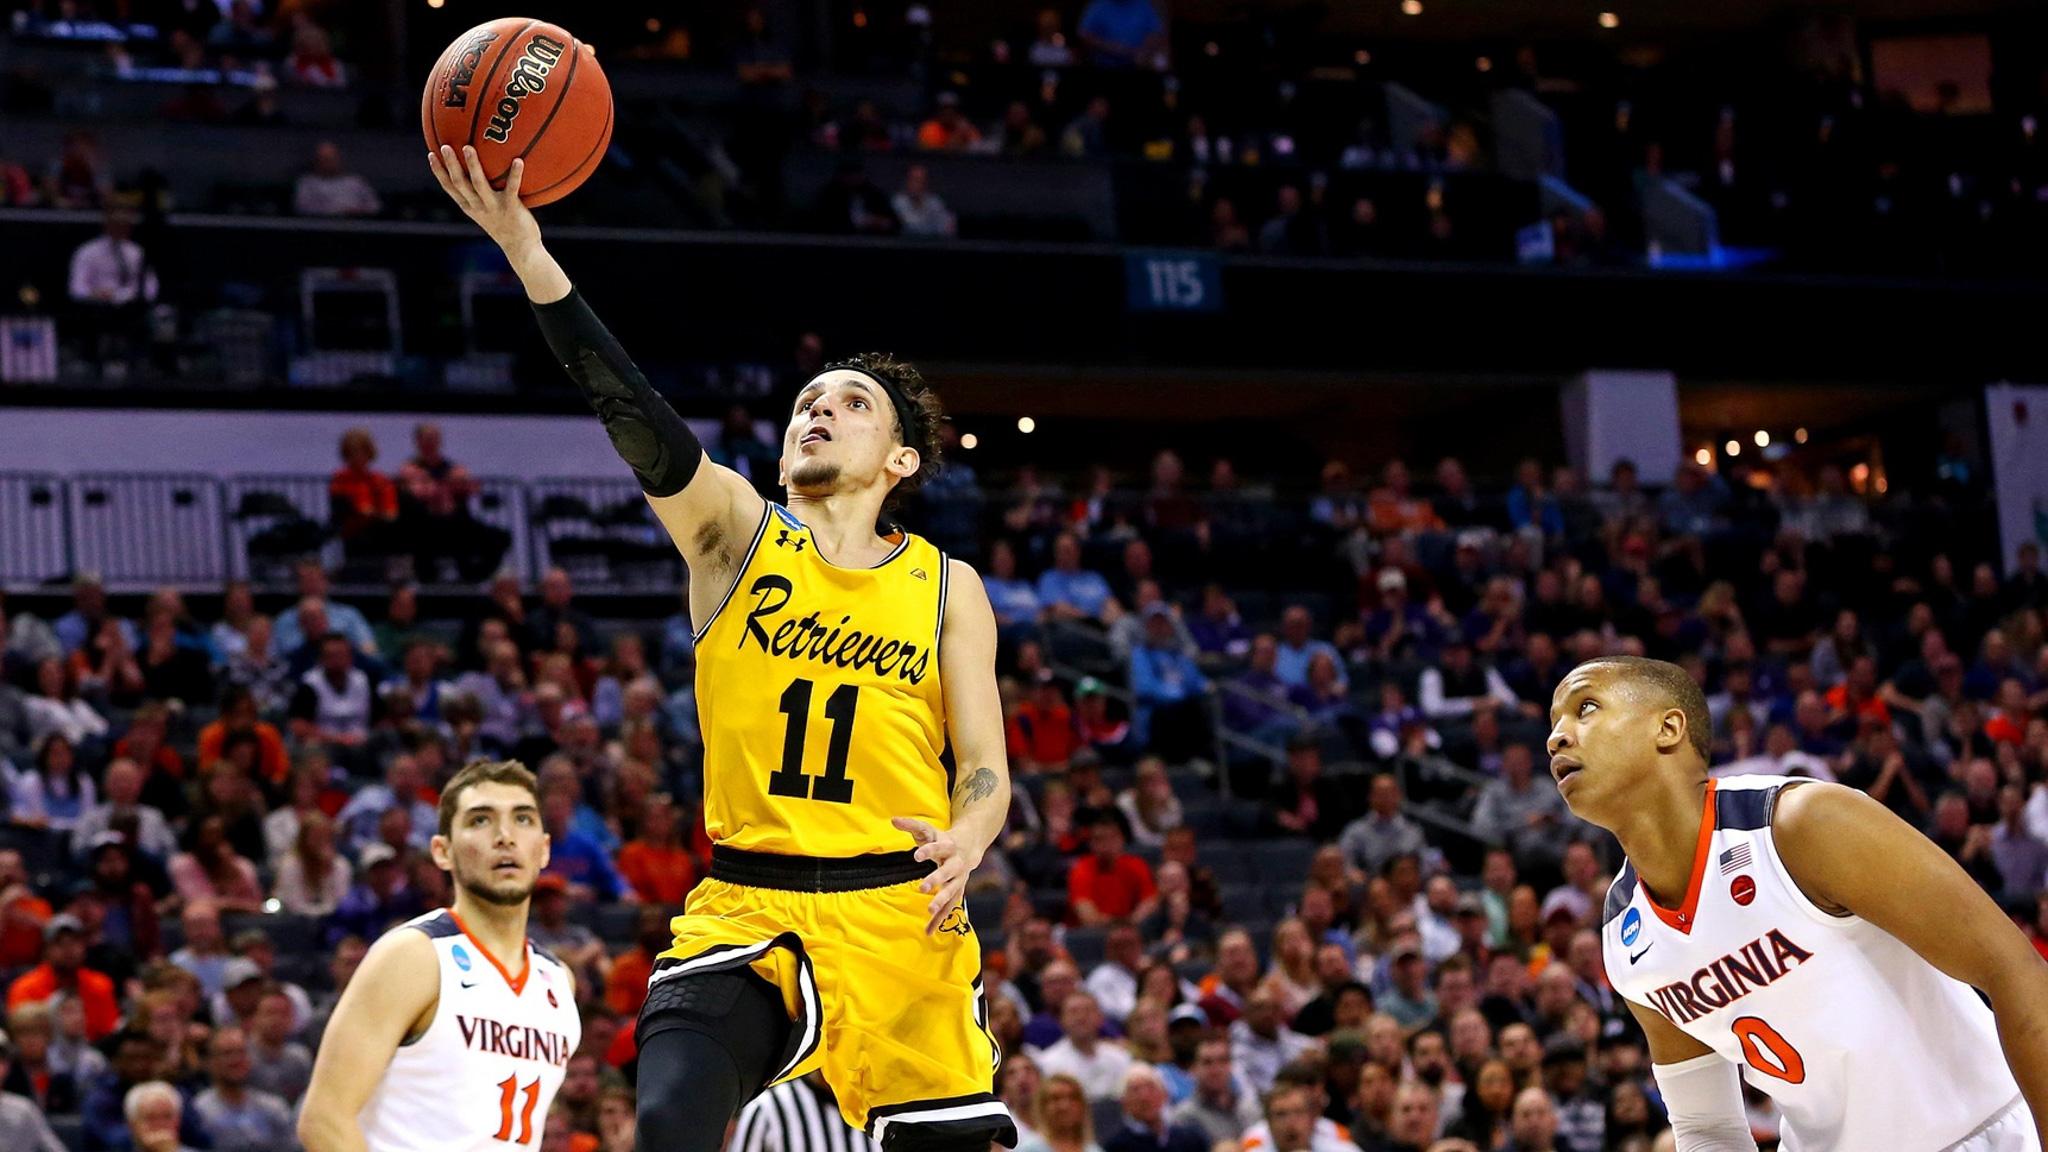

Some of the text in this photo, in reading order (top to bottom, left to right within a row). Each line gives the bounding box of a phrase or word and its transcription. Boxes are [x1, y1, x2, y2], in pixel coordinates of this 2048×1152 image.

[484, 34, 566, 144] Wilson
[1147, 260, 1204, 305] 115
[738, 574, 930, 686] Retrievers
[767, 677, 860, 804] 11
[1644, 927, 1814, 1026] VIRGINIA
[456, 1014, 571, 1069] VIRGINIA
[1731, 1015, 1806, 1085] 0
[492, 1071, 541, 1146] 11
